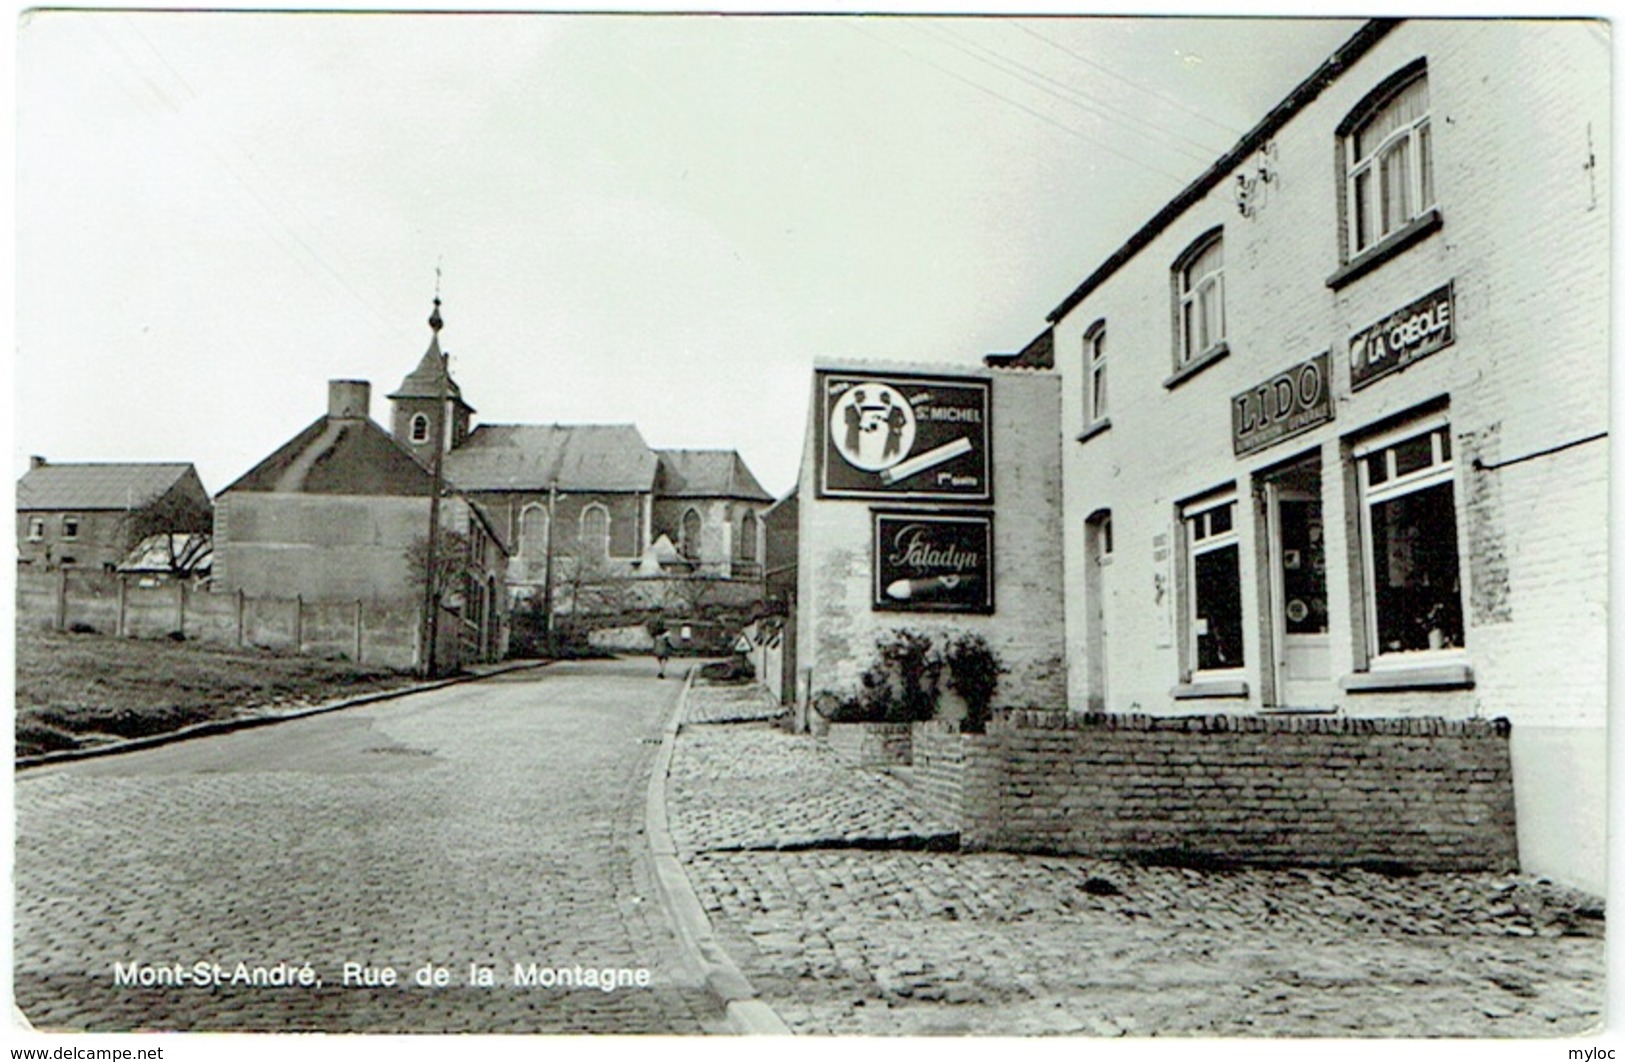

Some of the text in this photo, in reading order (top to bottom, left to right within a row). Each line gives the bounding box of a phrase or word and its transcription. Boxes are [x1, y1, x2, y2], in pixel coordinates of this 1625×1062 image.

[1367, 335, 1386, 364] LA
[1237, 361, 1321, 437] LIDO
[930, 406, 981, 423] MICHEL
